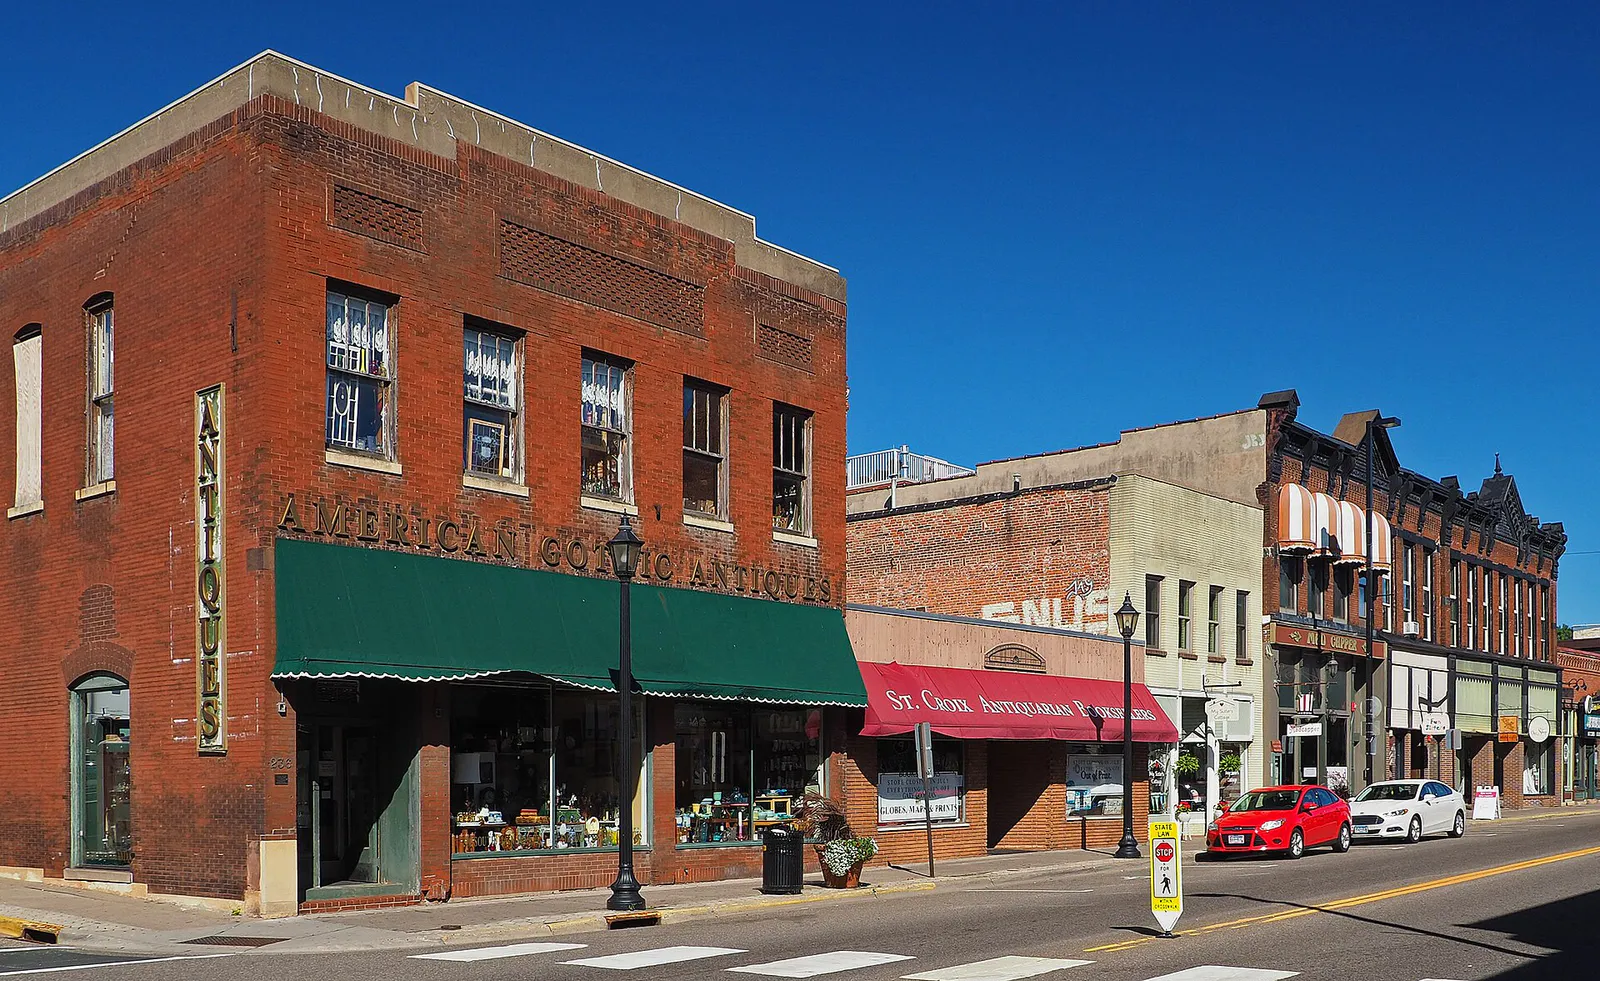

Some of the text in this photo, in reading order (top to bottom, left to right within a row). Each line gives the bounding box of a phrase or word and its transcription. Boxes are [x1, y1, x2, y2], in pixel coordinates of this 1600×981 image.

[277, 497, 832, 603] AMERICAN GOTIC ANTIQUES
[198, 400, 221, 740] ANTIQUES
[885, 689, 1156, 721] ST. CROIX ANTIQUARIAN BOOKSELERS
[935, 804, 958, 812] PRINTS
[1156, 848, 1173, 857] STOP
